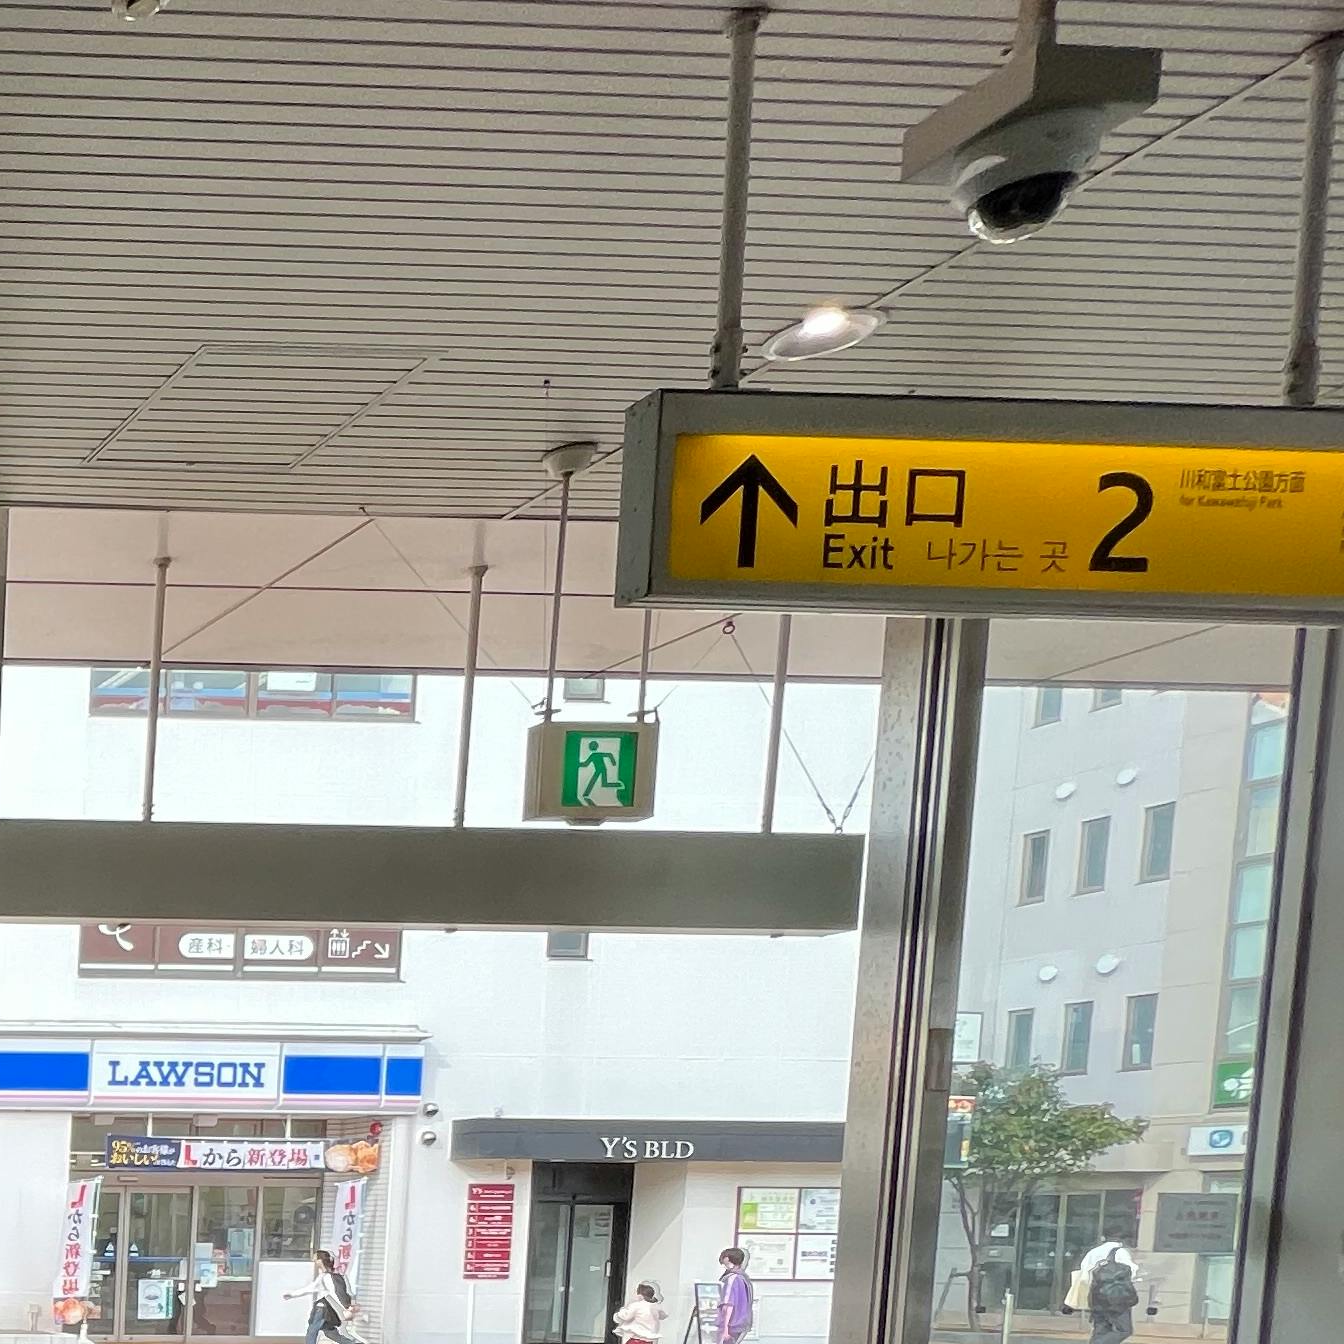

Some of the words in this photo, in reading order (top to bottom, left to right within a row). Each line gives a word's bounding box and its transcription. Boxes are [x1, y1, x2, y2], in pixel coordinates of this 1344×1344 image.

[824, 459, 966, 528] 出口
[1088, 471, 1154, 573] 2
[822, 533, 895, 570] Exit
[927, 537, 1024, 573] 나가는
[1039, 540, 1069, 573] 곳
[250, 939, 305, 957] 婦人科
[107, 1060, 266, 1089] LAWSON
[643, 1140, 695, 1159] BLD
